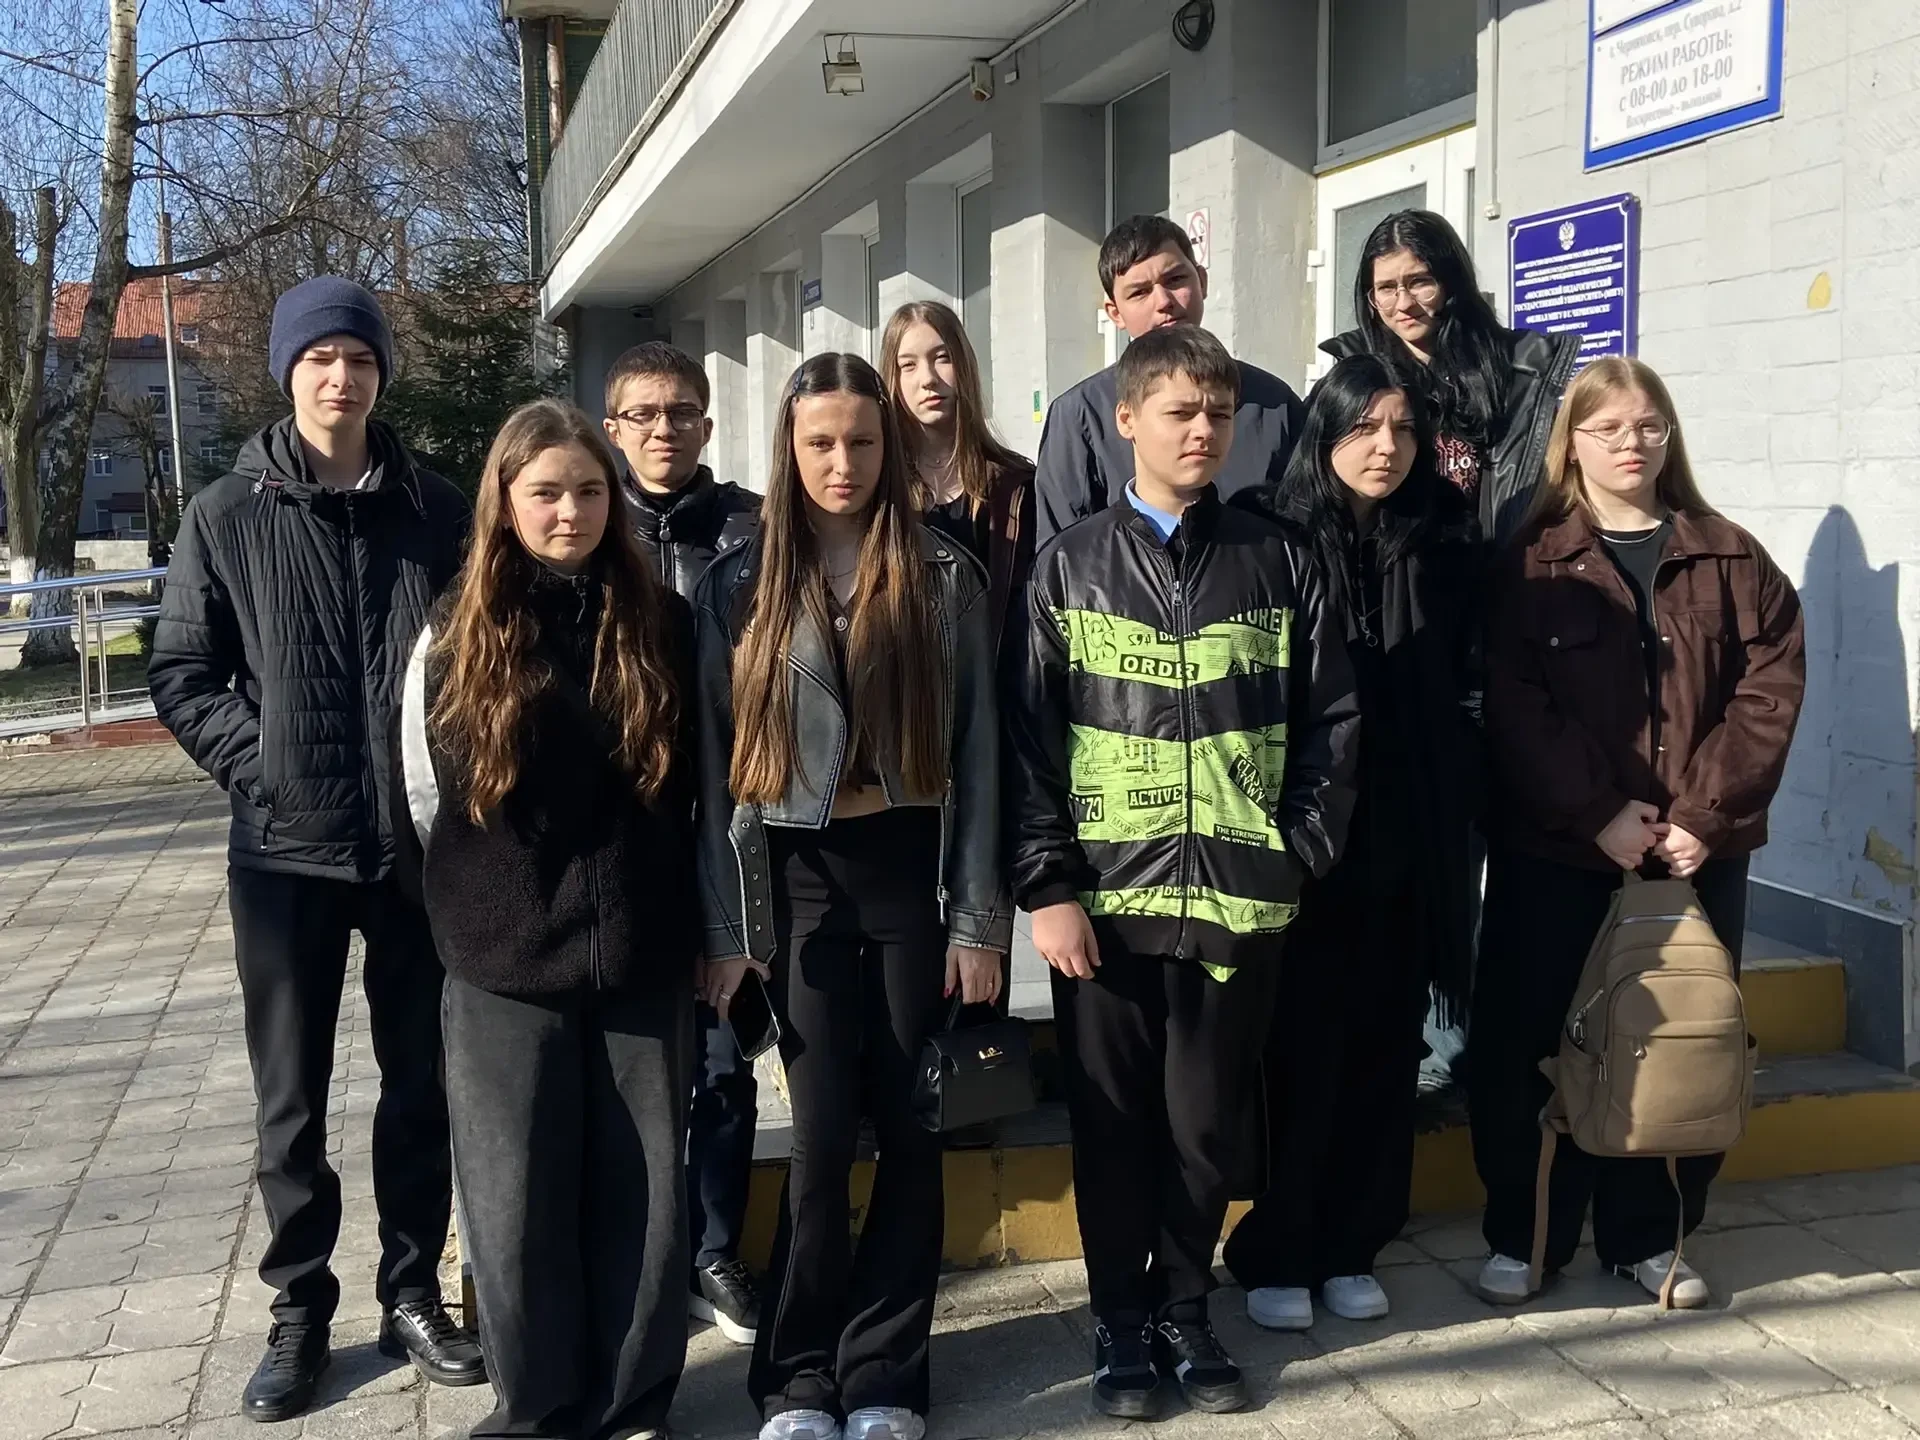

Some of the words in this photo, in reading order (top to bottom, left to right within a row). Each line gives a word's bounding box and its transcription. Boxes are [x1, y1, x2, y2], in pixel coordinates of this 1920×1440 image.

[1620, 50, 1668, 85] РЕЖИМ
[1672, 29, 1733, 68] РАБОТЫ:
[1630, 77, 1667, 108] 08-00
[1693, 55, 1733, 89] 18-00
[1123, 656, 1195, 680] ORDER
[1129, 785, 1182, 806] ACTIVE
[1215, 825, 1230, 835] THE
